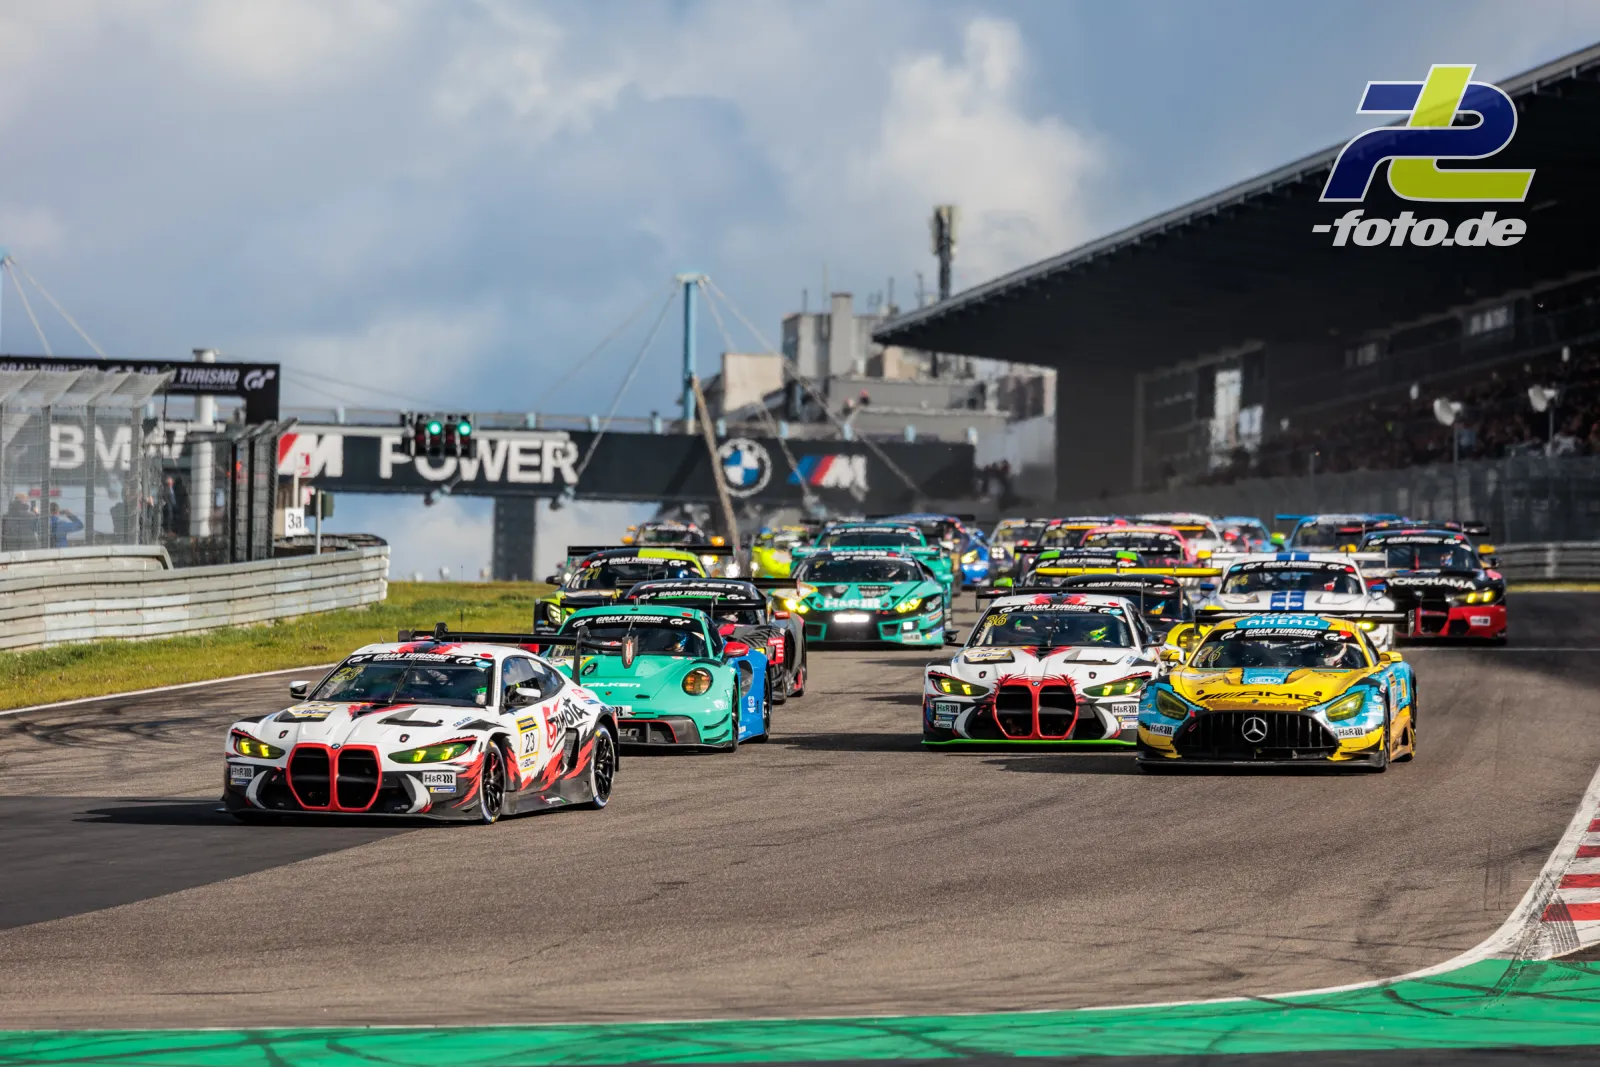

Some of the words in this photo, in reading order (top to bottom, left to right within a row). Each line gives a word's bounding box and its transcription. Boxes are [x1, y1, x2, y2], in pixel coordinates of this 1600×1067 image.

[179, 368, 239, 385] TURISMO
[380, 433, 579, 484] POWER
[288, 513, 302, 529] 3a
[1386, 577, 1477, 591] YOKOHAMA
[985, 613, 1009, 627] 36
[1246, 618, 1319, 627] AHEAD
[1274, 628, 1318, 636] TURISMO
[373, 653, 404, 661] GRAN
[404, 653, 451, 661] TURISMO
[1199, 645, 1224, 662] 26
[525, 731, 535, 753] 23
